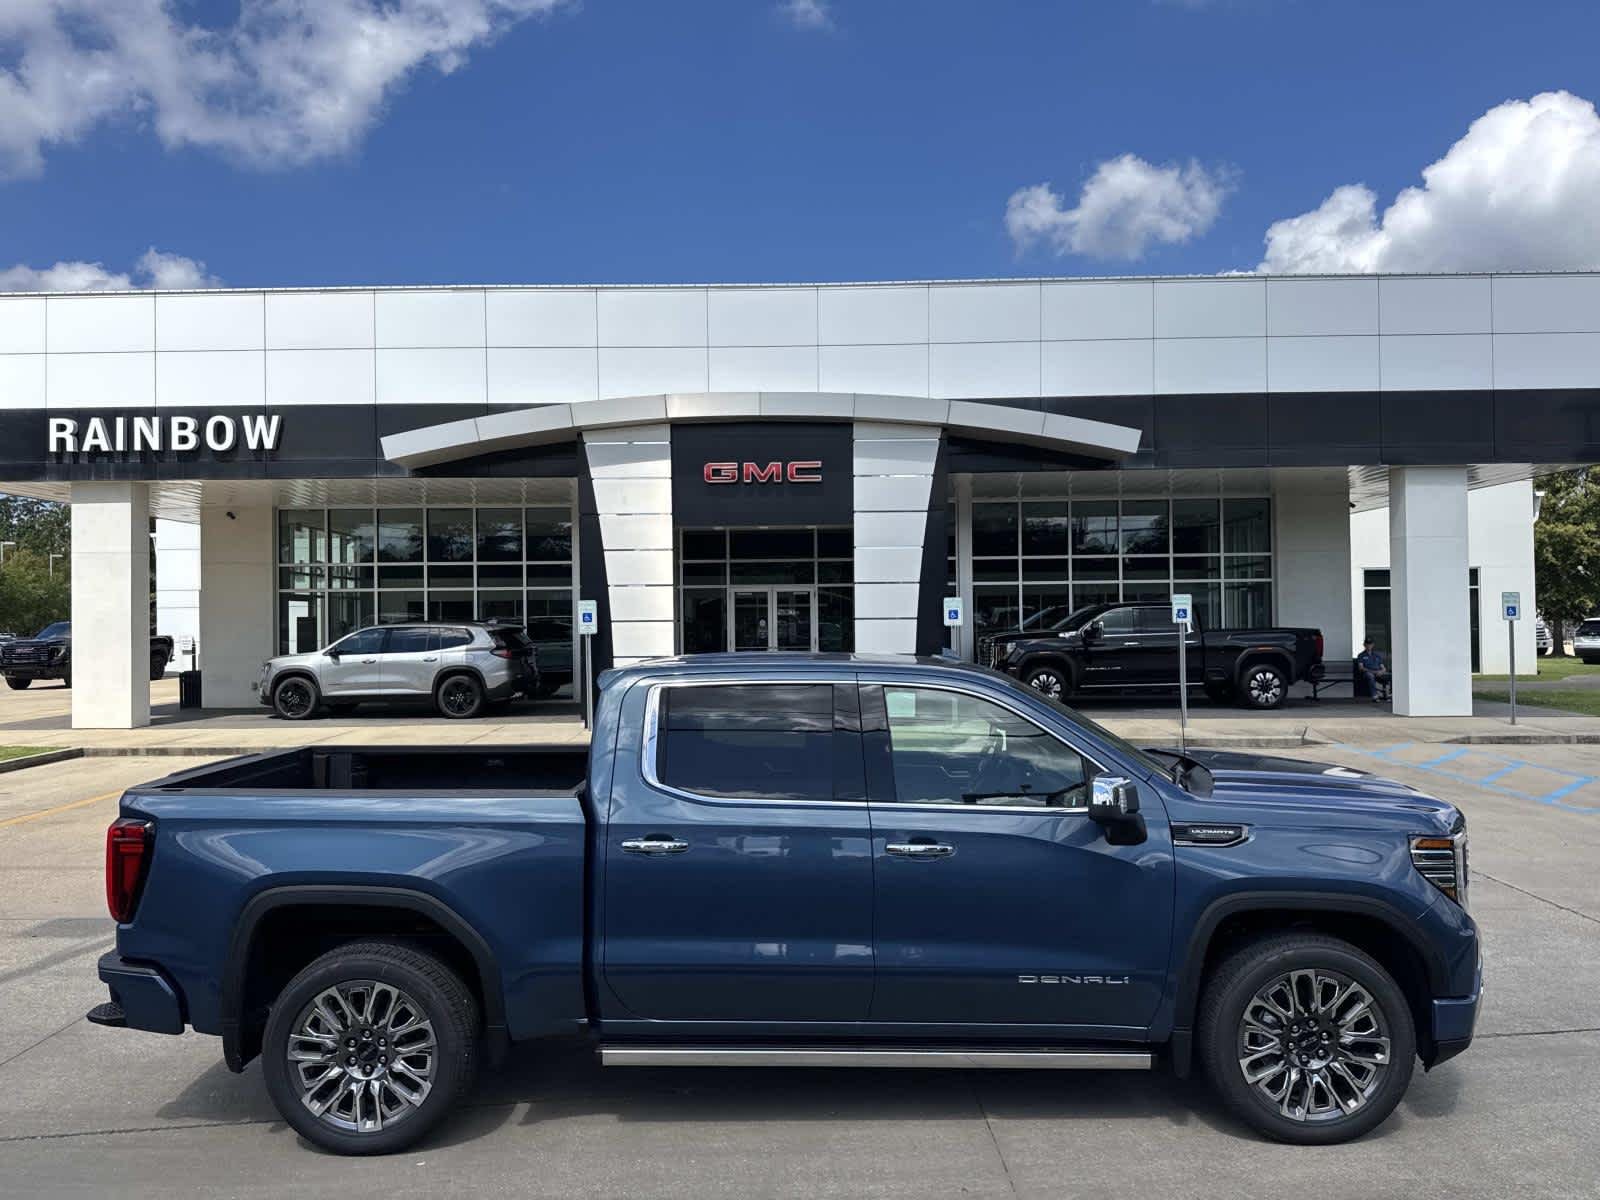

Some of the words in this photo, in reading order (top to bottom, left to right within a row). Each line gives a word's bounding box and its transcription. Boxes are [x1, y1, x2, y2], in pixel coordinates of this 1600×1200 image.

[48, 414, 281, 452] RAINBOW
[703, 460, 822, 483] GMC
[1018, 975, 1129, 984] DENALI
